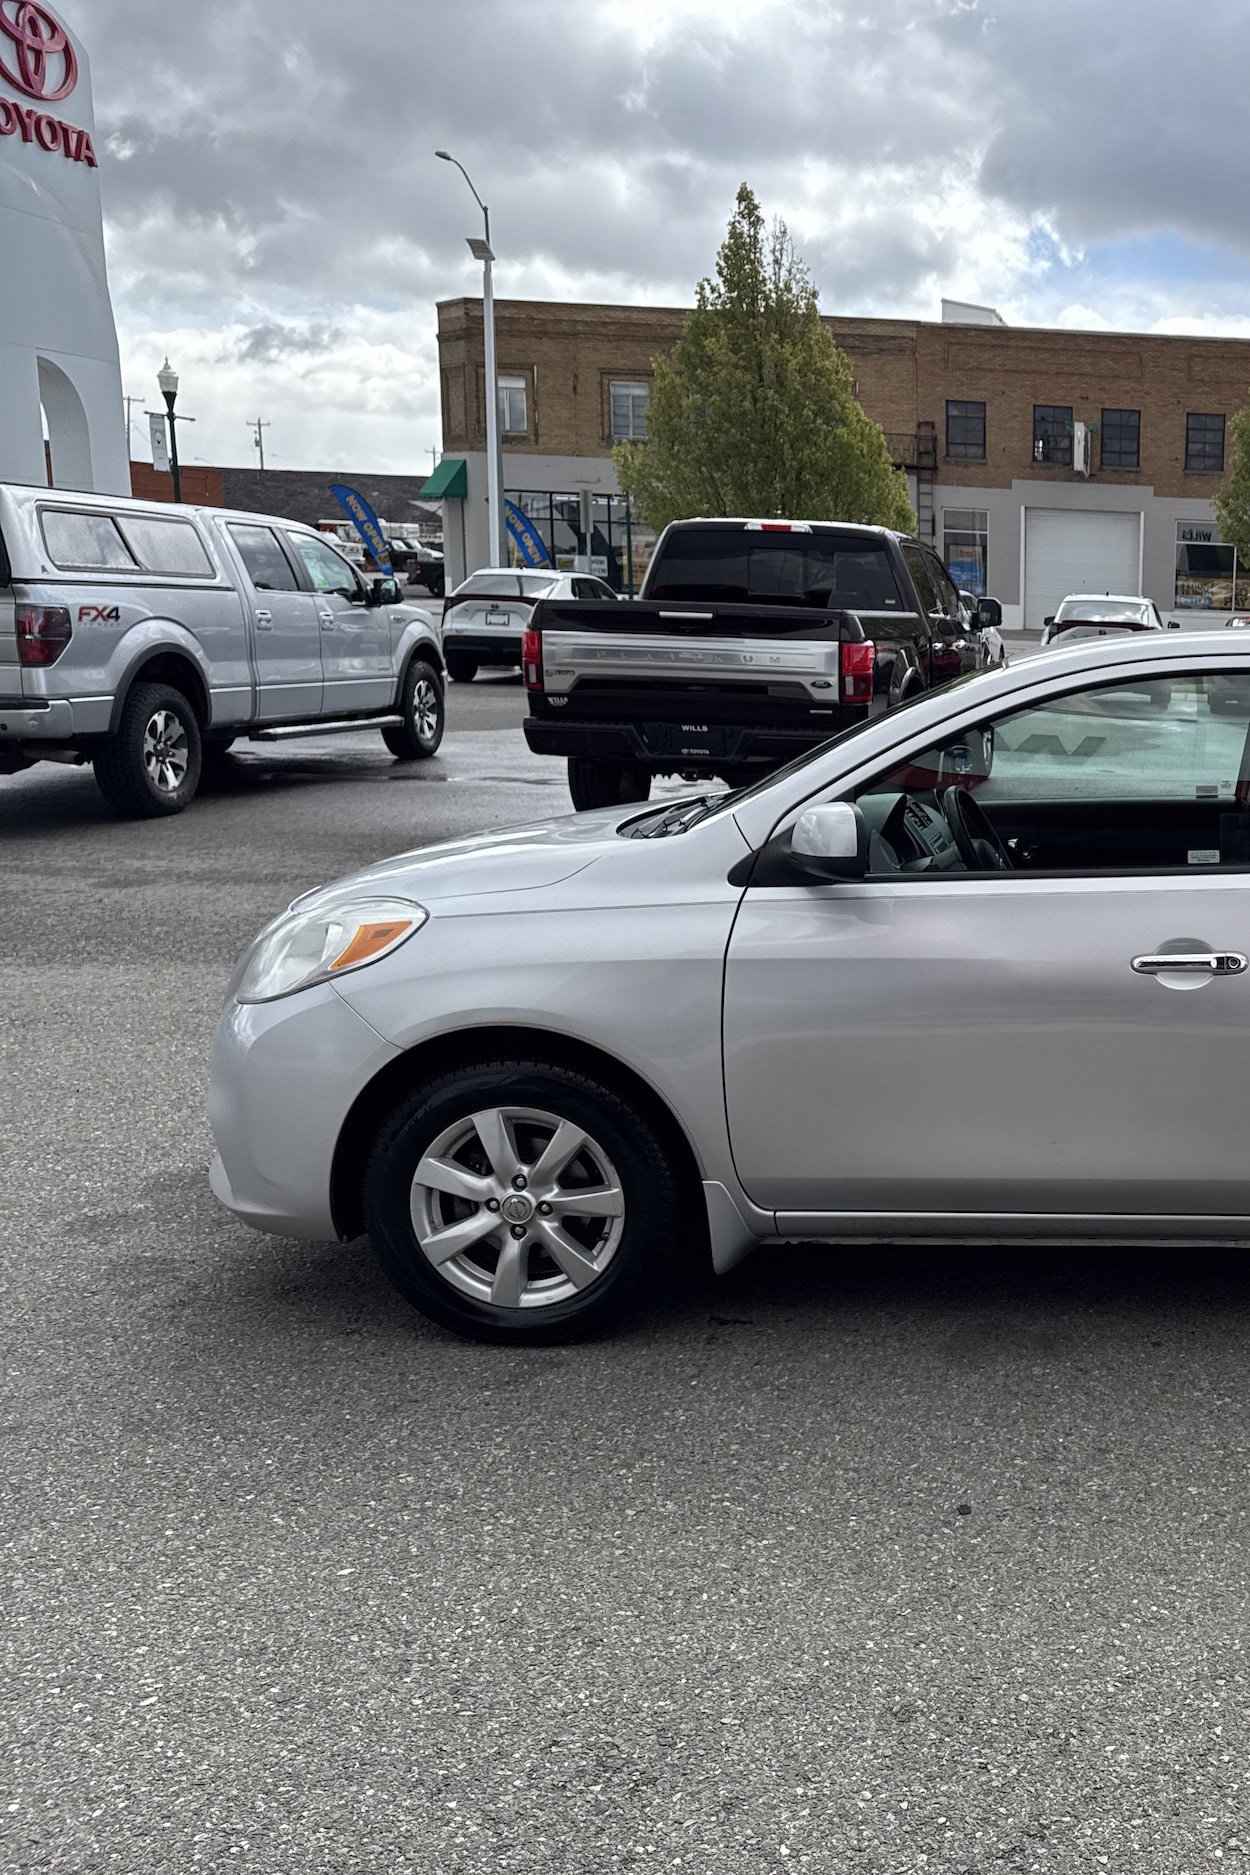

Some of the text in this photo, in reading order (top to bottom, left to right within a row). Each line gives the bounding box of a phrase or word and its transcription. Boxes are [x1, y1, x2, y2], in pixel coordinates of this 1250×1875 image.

[345, 494, 369, 520] NOW
[363, 522, 385, 551] OPEN
[522, 532, 543, 564] OPEN
[77, 605, 121, 622] FX4
[681, 724, 709, 732] WILLS
